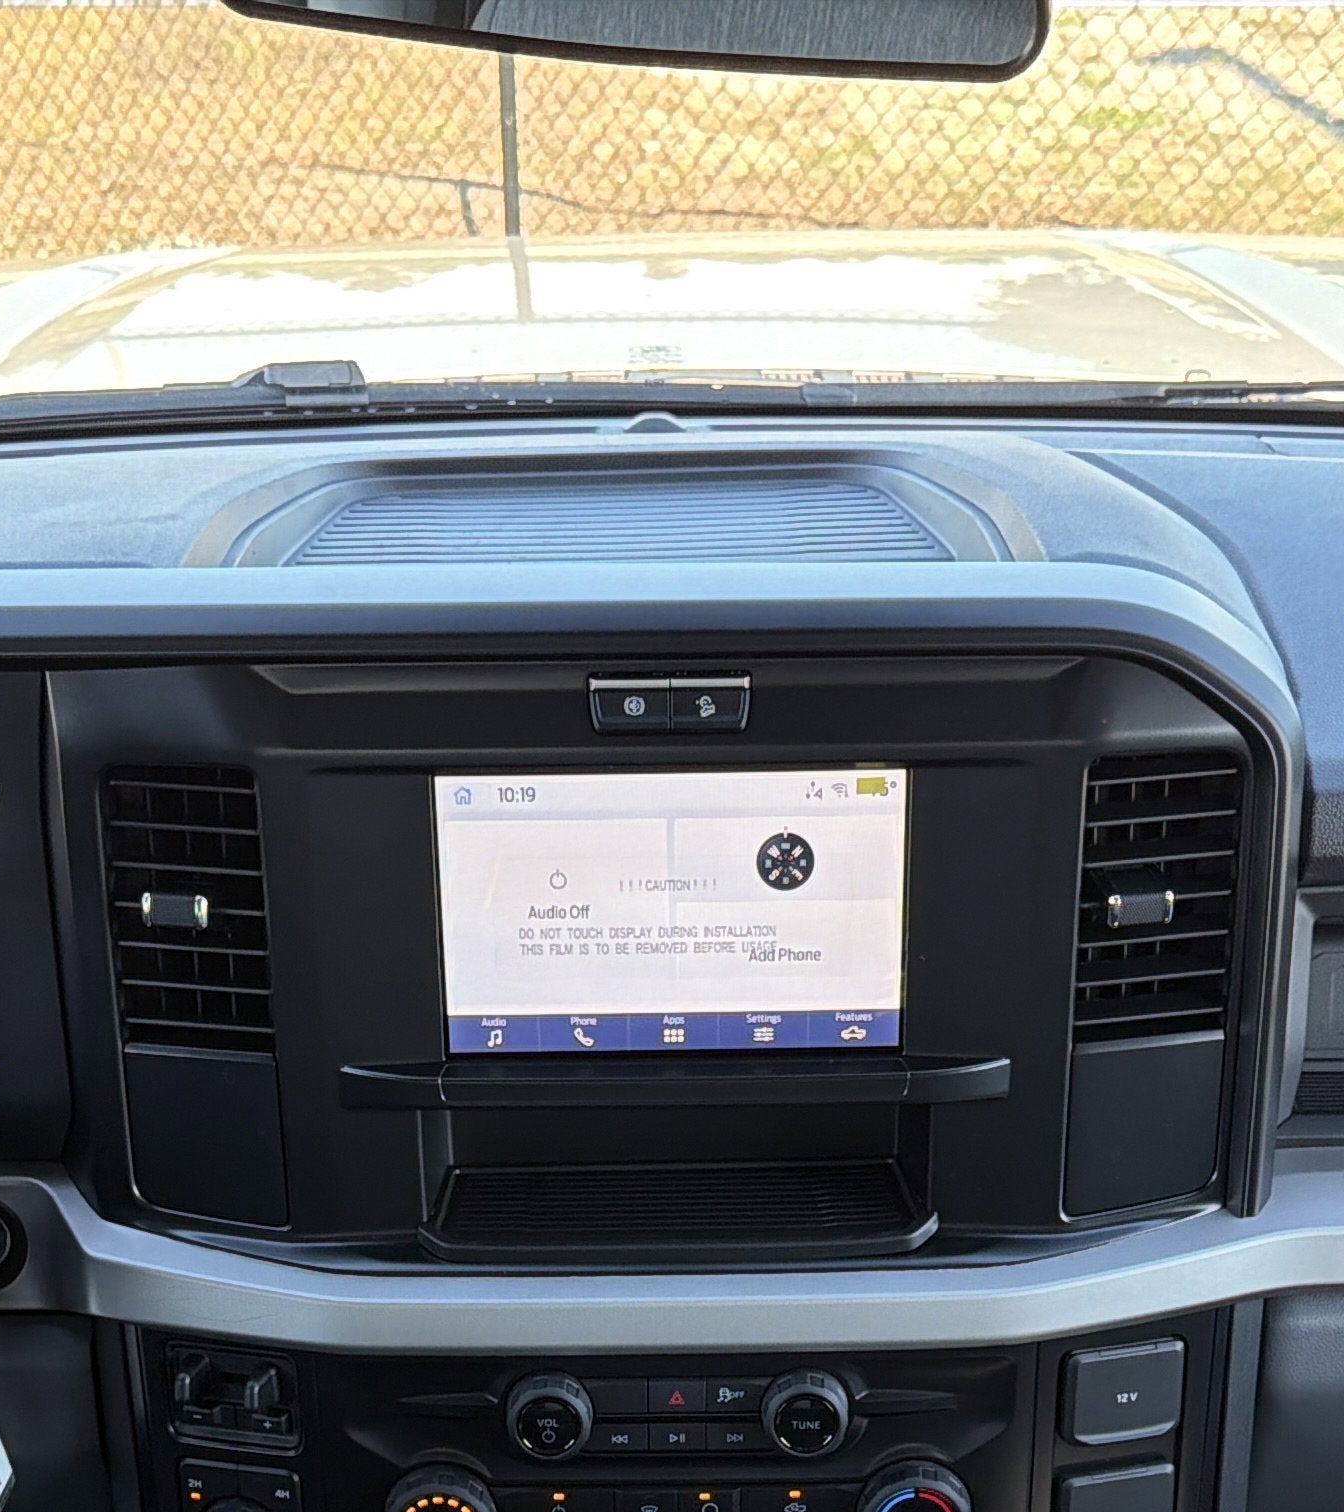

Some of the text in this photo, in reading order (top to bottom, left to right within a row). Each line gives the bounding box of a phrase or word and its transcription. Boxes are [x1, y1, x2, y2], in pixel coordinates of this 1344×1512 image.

[497, 786, 536, 803] 10:19
[528, 903, 591, 919] Audio Off
[518, 925, 777, 940] DO NOT TOUCH DISPLAY DURING INSTALLATION
[520, 940, 777, 956] THIS FILM IS TO BE REMOVED BEFORE USAGE
[748, 948, 822, 962] Add Phone
[481, 1017, 507, 1027] Audio
[570, 1017, 597, 1026] Phone
[663, 1015, 685, 1026] Apps
[746, 1013, 782, 1025] Settings
[835, 1012, 874, 1022] Features
[728, 1390, 744, 1399] OFF
[1116, 1392, 1138, 1403] 12 V
[537, 1418, 560, 1427] VOL
[792, 1420, 821, 1430] TUNE
[187, 1478, 202, 1488] 2H
[275, 1489, 290, 1499] 4H
